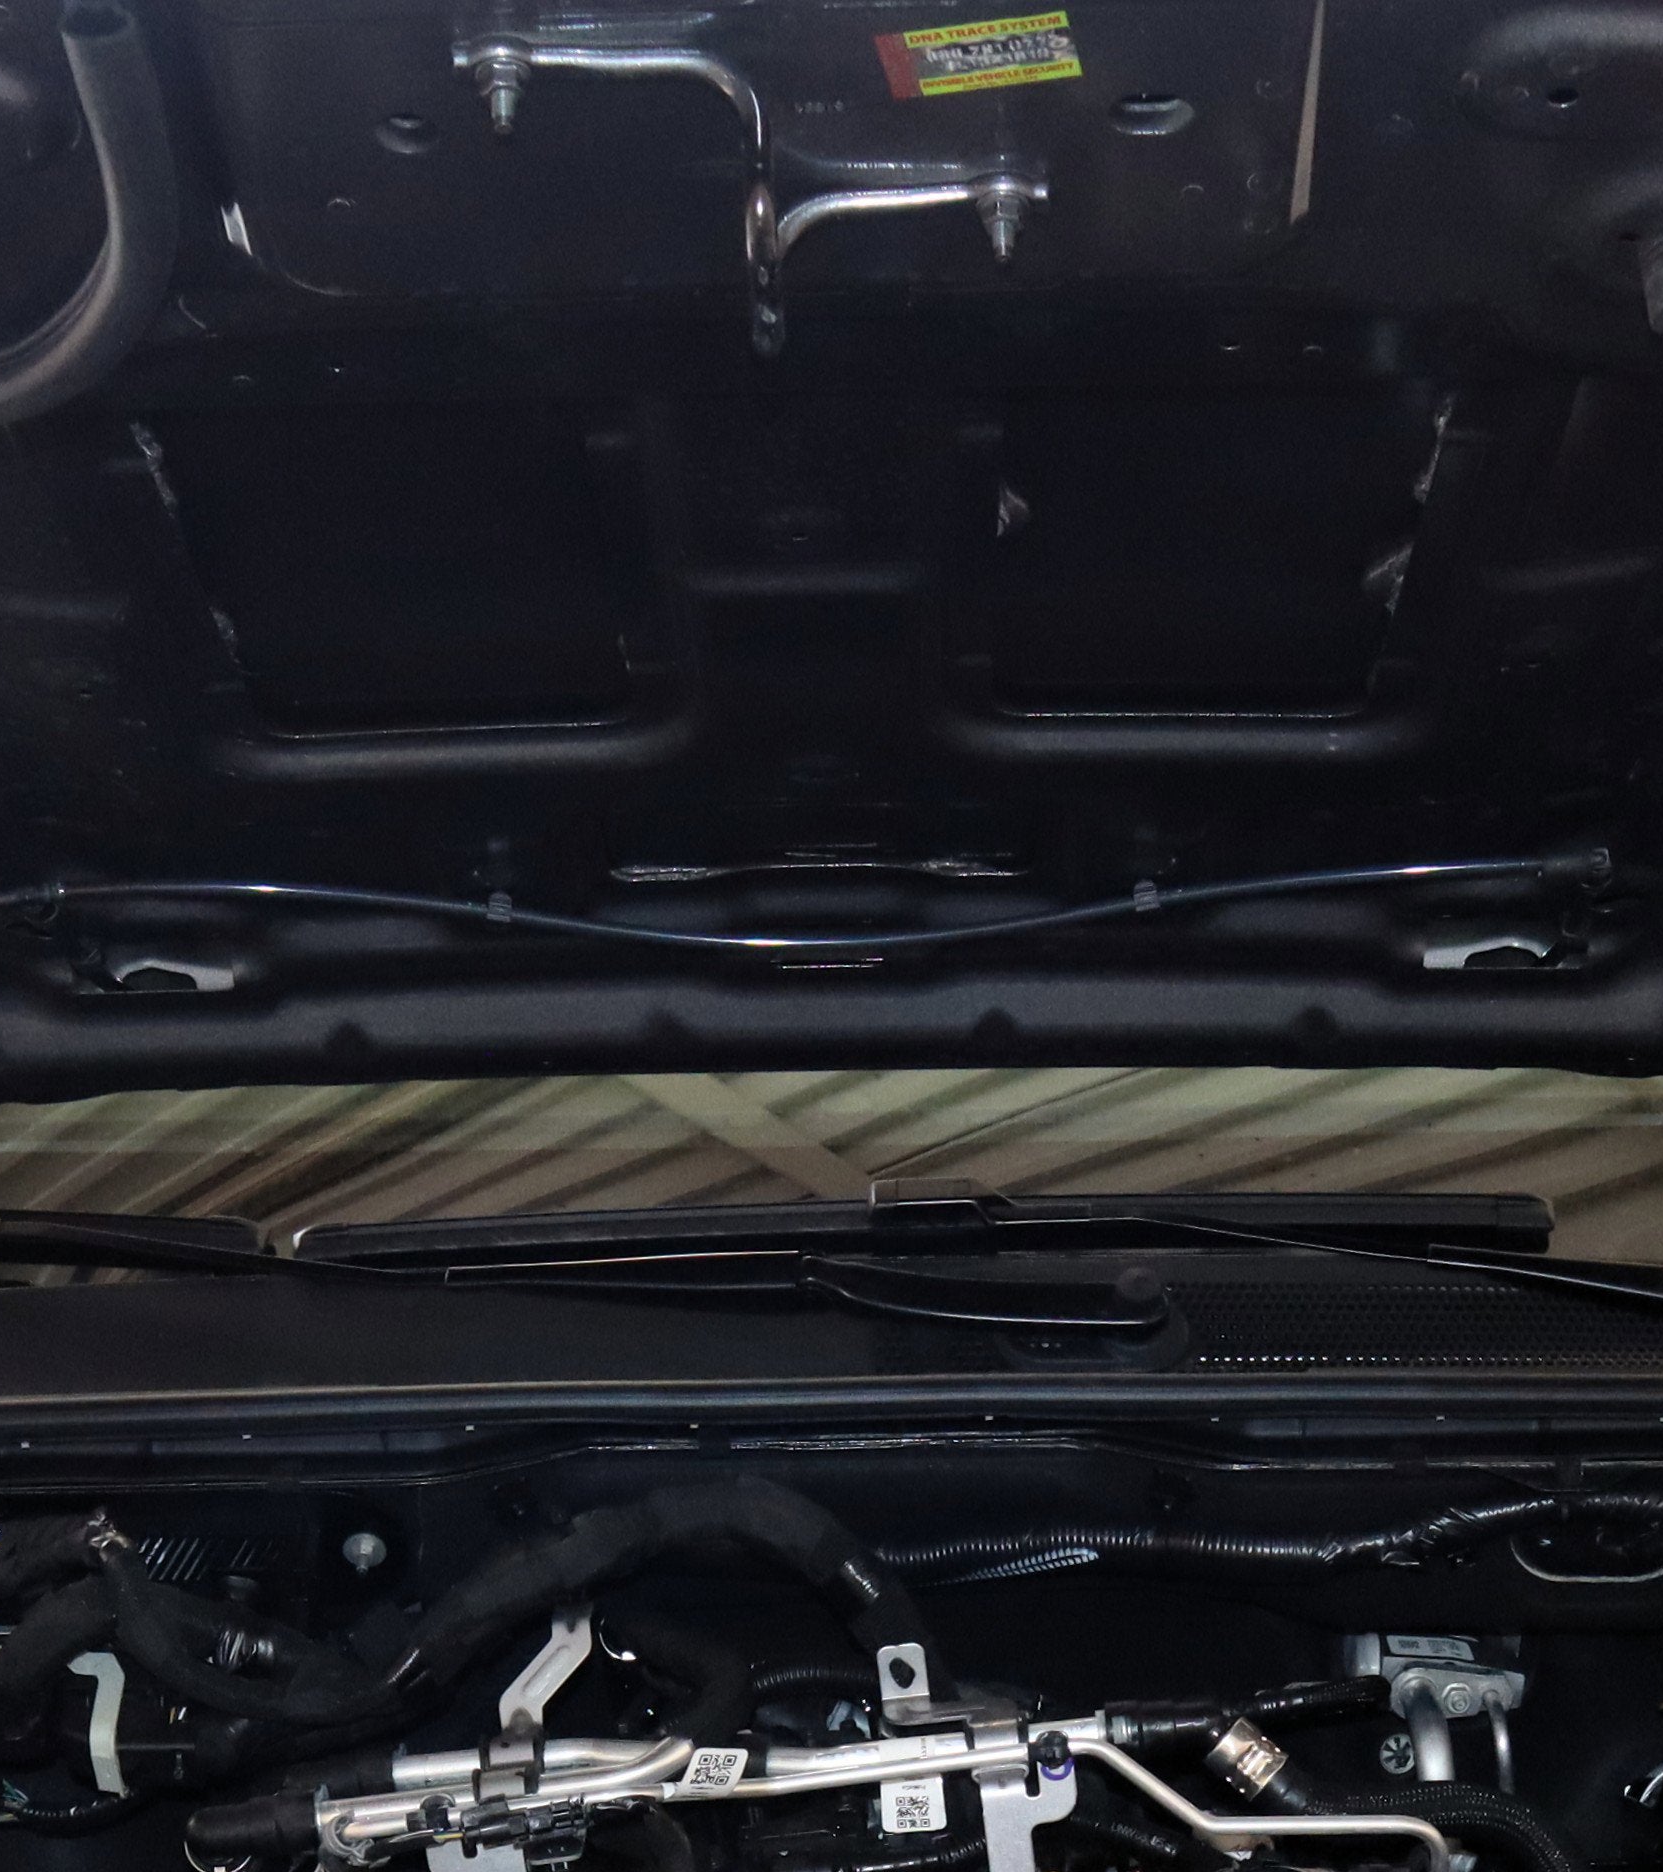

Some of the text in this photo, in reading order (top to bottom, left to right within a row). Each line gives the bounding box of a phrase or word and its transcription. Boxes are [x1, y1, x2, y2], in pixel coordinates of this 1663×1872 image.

[908, 14, 1062, 44] DNA TRACE SYSTEM
